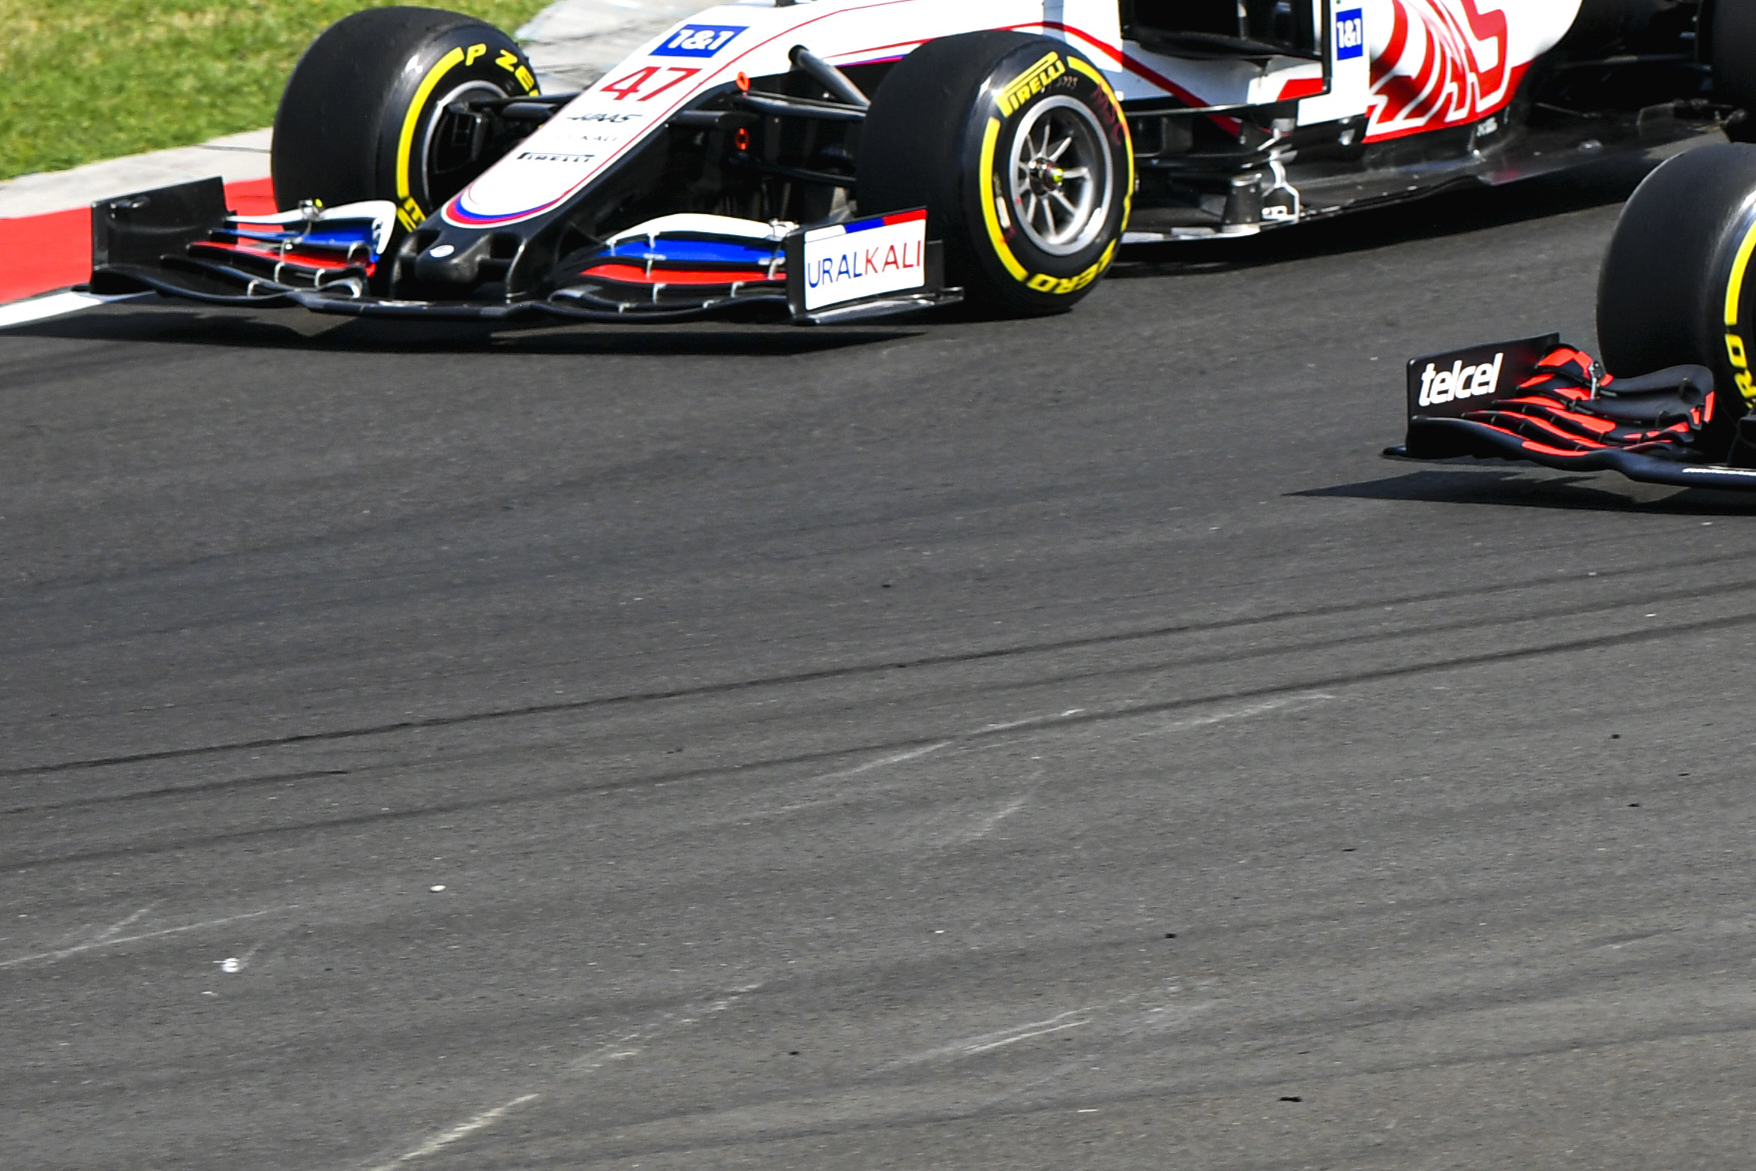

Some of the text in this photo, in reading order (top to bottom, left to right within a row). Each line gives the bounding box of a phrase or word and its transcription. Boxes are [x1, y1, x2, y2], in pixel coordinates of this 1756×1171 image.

[668, 28, 736, 51] 1&1
[1336, 17, 1362, 49] 1&1
[599, 65, 703, 102] 47
[993, 51, 1066, 117] PIRELLI
[807, 239, 923, 290] URALKALI
[1418, 352, 1504, 407] telcel
